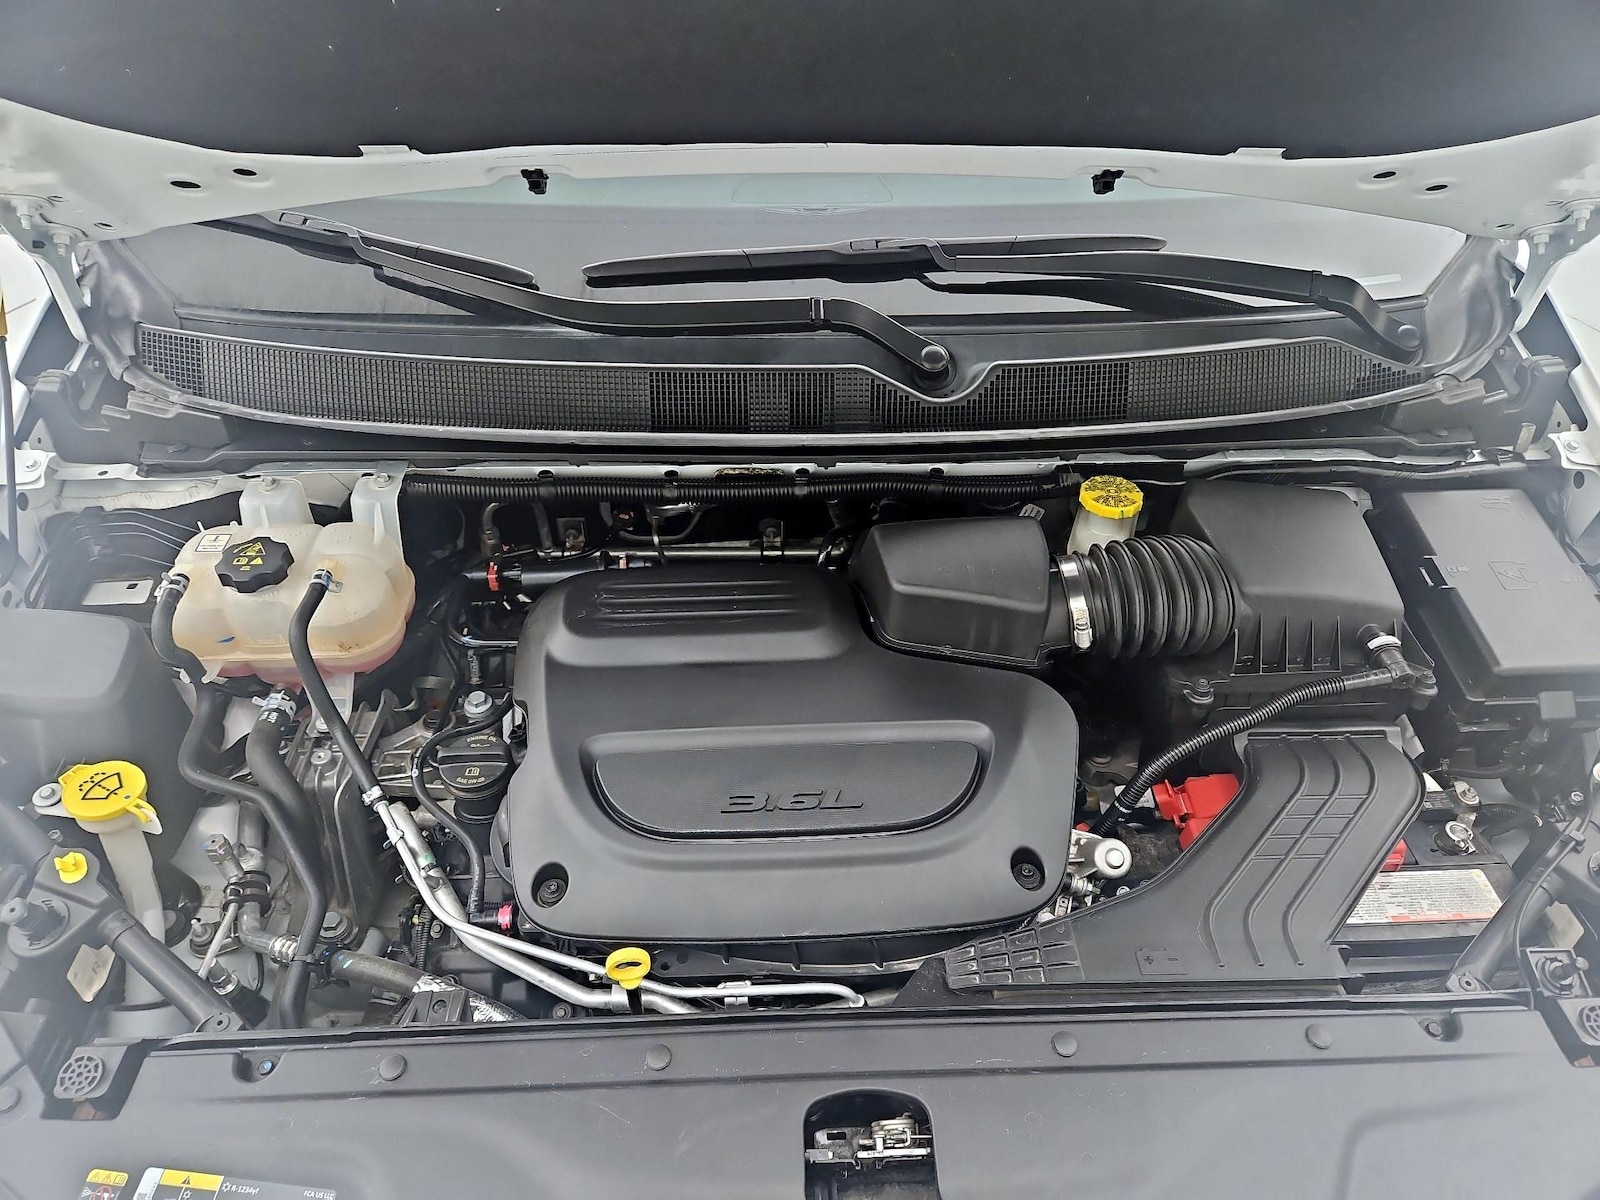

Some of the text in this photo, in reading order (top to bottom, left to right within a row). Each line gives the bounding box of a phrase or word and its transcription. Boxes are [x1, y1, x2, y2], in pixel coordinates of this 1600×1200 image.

[488, 735, 498, 743] OIL
[456, 776, 468, 784] SAE
[720, 789, 863, 813] 3.6L
[231, 1184, 260, 1196] R-1234yf
[303, 1190, 335, 1200] FCA US LLC
